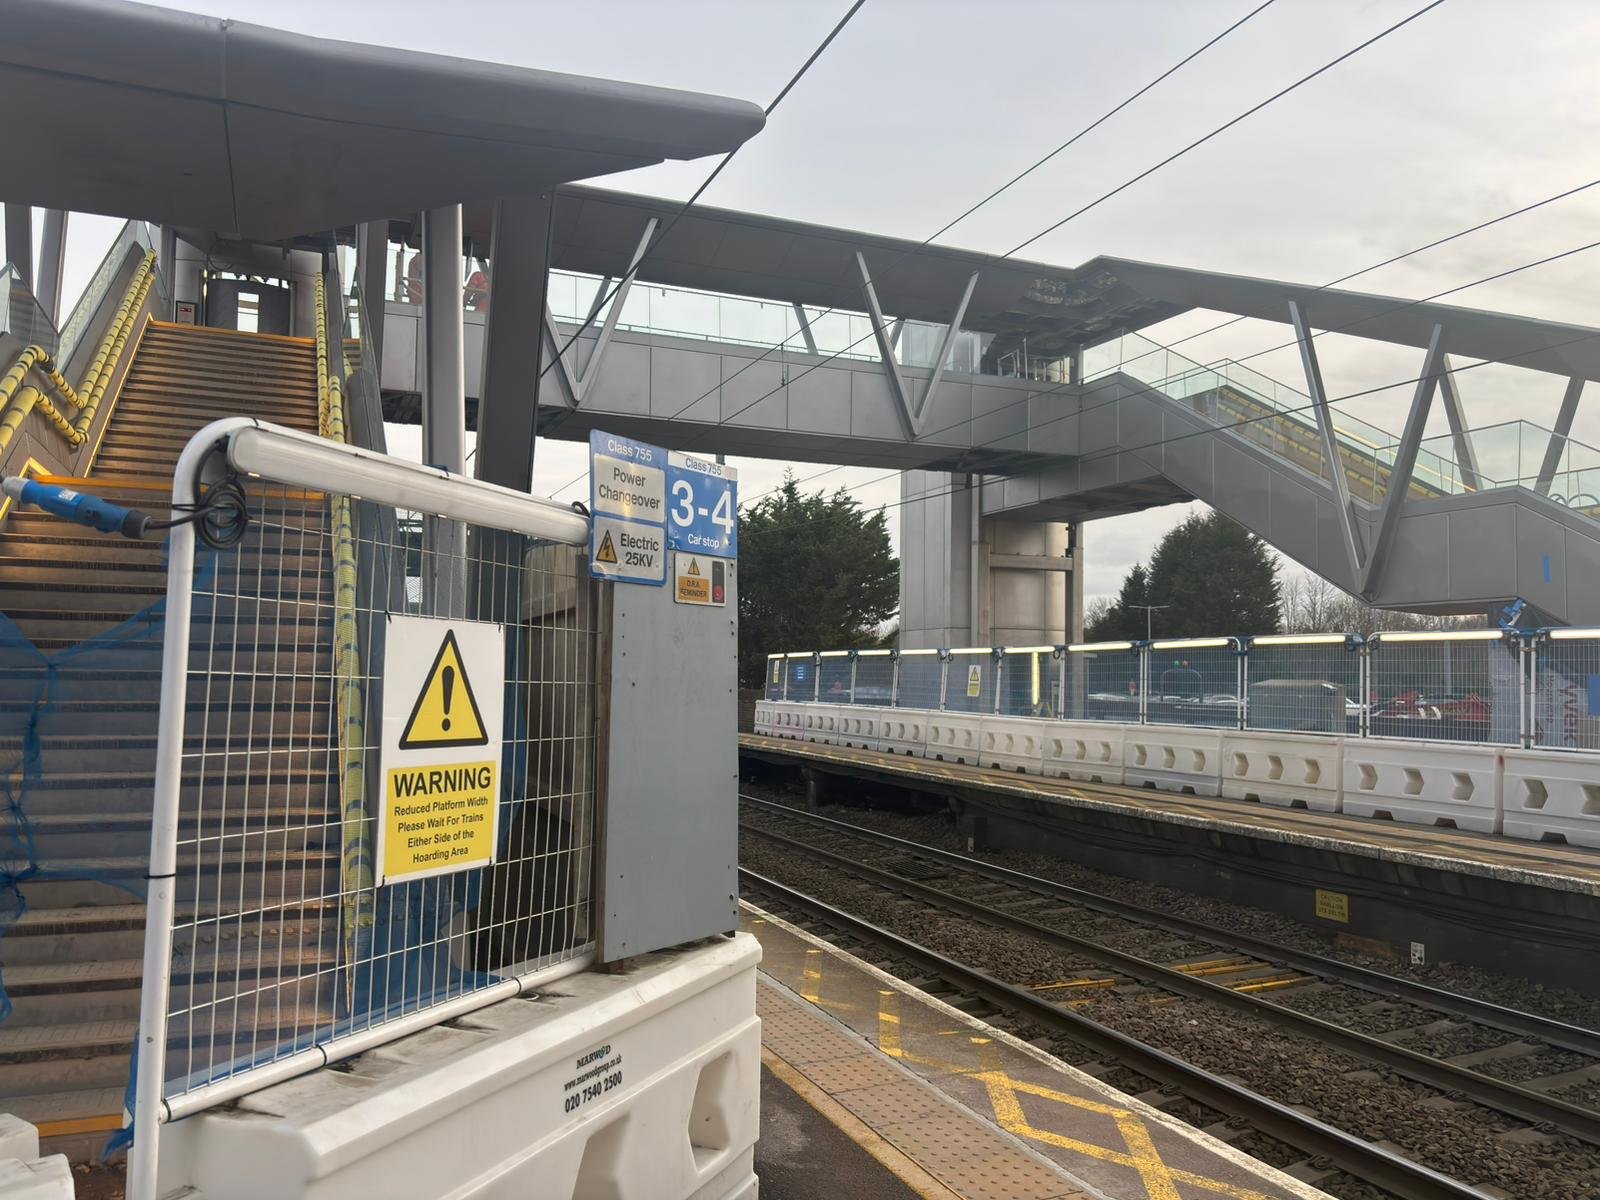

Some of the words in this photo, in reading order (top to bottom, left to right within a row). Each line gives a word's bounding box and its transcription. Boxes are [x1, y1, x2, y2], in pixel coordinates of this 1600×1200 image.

[608, 439, 633, 457] Class
[634, 446, 652, 462] 755
[613, 467, 646, 487] Power
[685, 458, 706, 473] Class
[707, 463, 722, 476] 755
[599, 484, 660, 510] Changeover
[671, 479, 734, 535] 3-4
[620, 533, 659, 552] Electric
[688, 533, 702, 545] Car
[702, 537, 720, 549] stop
[625, 551, 654, 568] 25KV
[1560, 684, 1578, 741] yvek
[394, 766, 491, 798] WARNING
[394, 803, 431, 817] Reduced
[432, 799, 466, 812] Platform
[466, 796, 489, 808] Width
[397, 820, 425, 833] Please
[427, 818, 445, 829] Wait
[446, 816, 460, 826] For
[461, 812, 484, 824] Trains
[407, 836, 432, 849] Either
[433, 833, 451, 844] Side
[452, 831, 462, 840] of
[462, 829, 475, 839] the
[412, 849, 450, 864] Hoarding
[450, 846, 469, 857] Area
[564, 1053, 622, 1091] www.marwoodgroup.co.uk
[564, 1093, 581, 1113] 020
[582, 1081, 602, 1104] 7540
[603, 1070, 623, 1092] 2500
